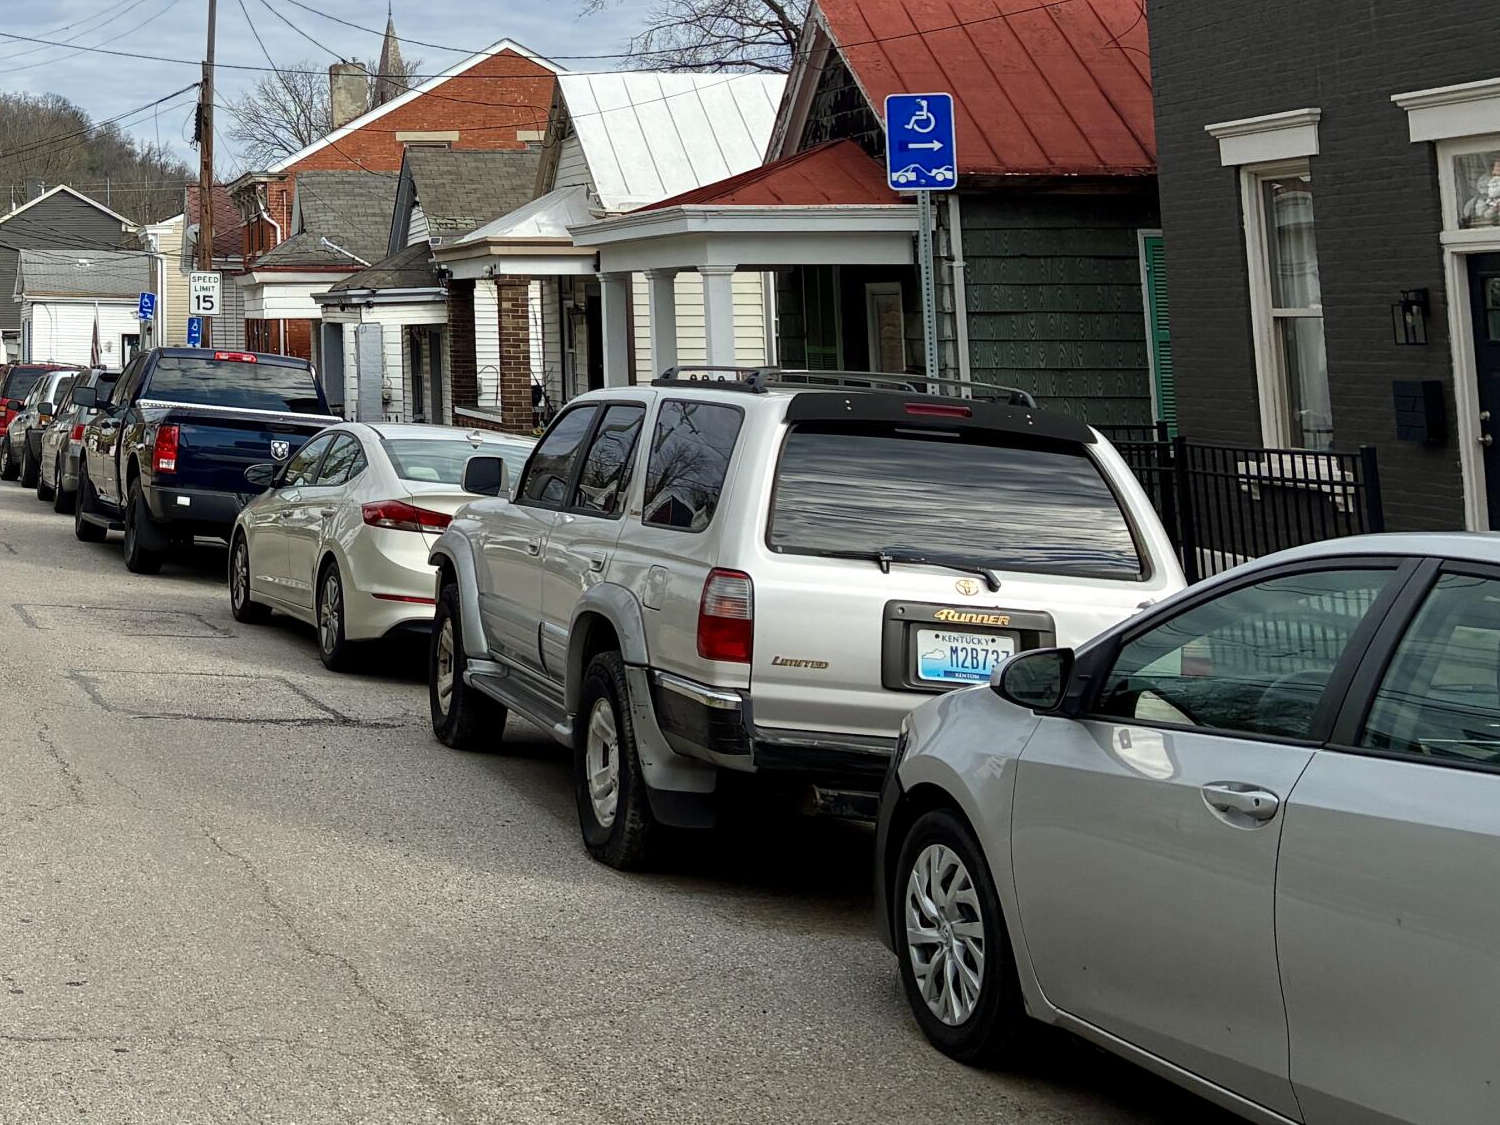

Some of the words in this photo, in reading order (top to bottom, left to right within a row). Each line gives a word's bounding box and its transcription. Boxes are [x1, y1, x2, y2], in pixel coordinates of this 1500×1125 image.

[192, 276, 218, 284] SPEED
[195, 295, 214, 311] 15
[941, 634, 990, 646] KENTUCKY
